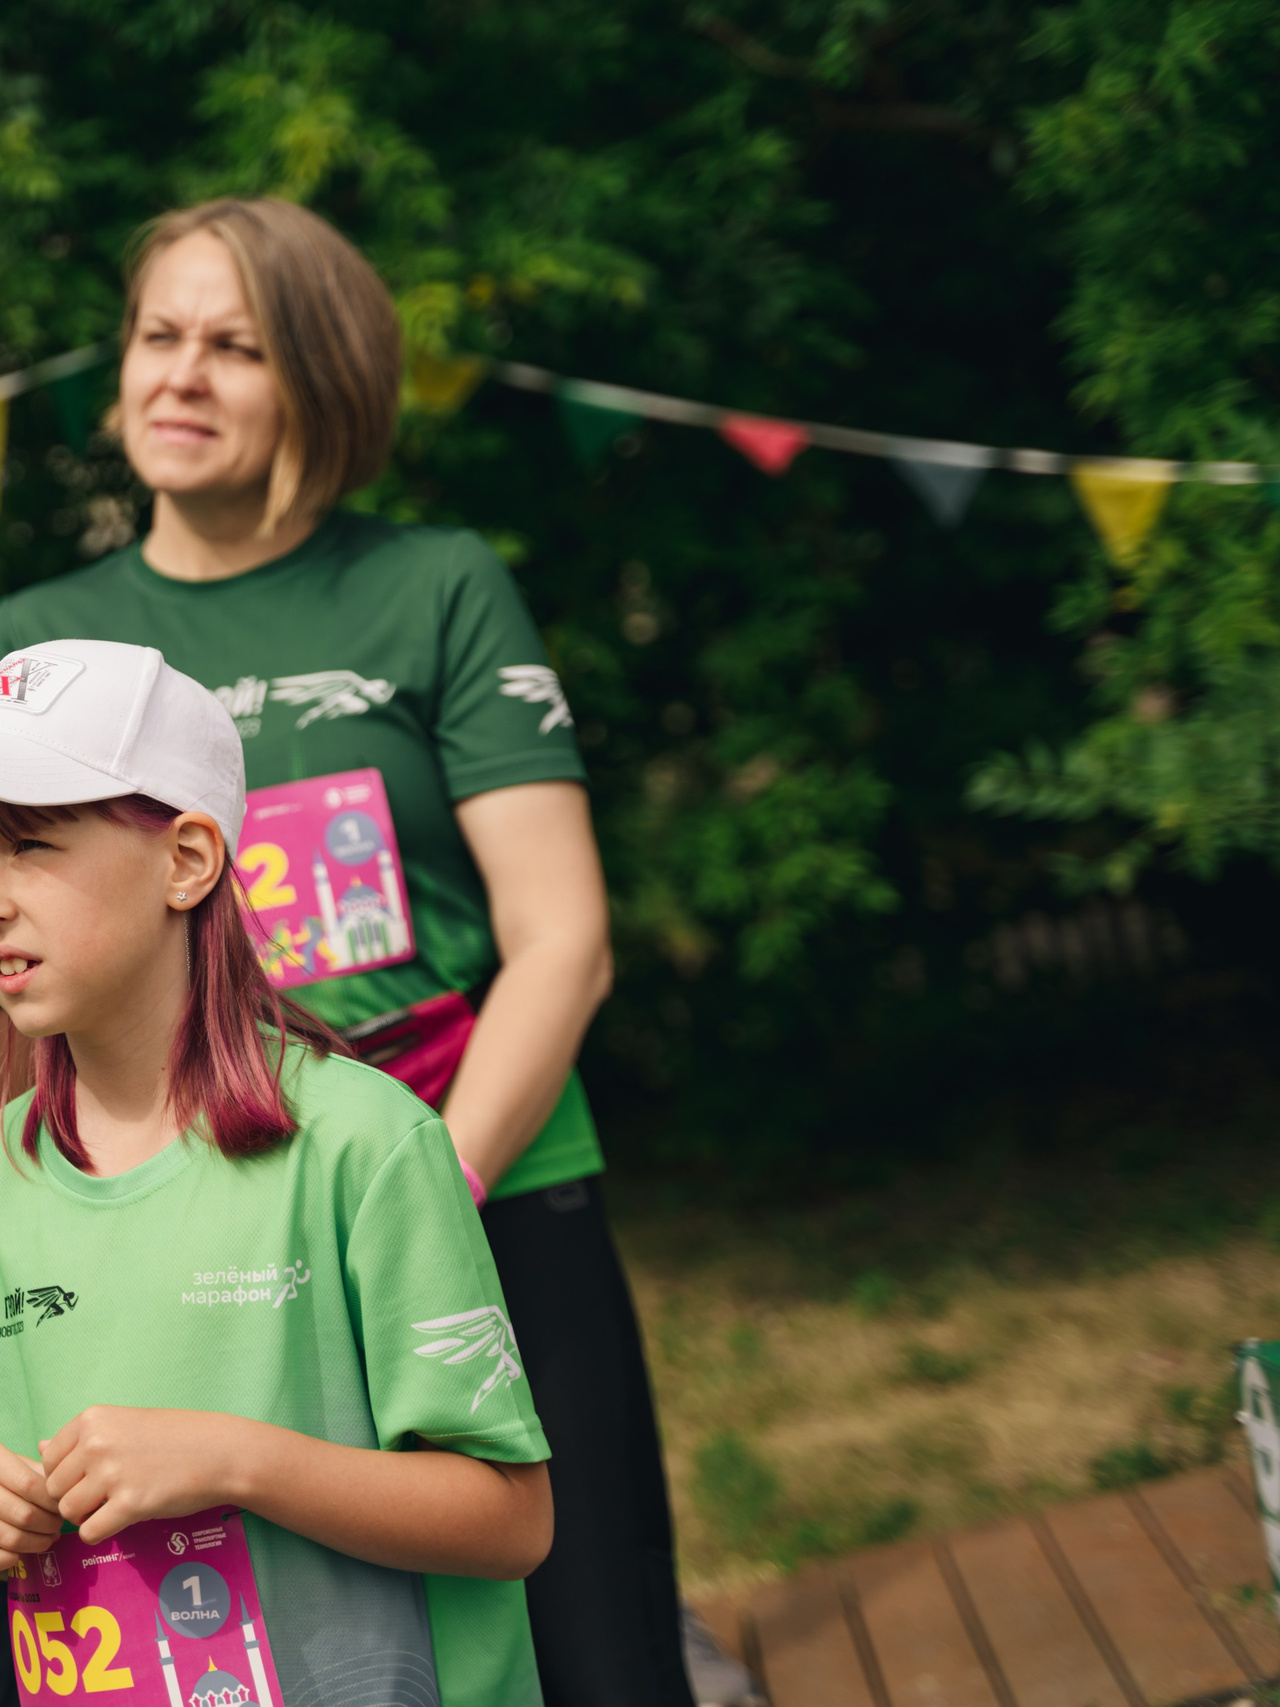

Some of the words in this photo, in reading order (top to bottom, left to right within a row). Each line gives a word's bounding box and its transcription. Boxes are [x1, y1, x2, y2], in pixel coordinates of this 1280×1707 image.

[192, 1262, 279, 1286] зелёный
[181, 1284, 272, 1307] марафон
[183, 1576, 203, 1606] 1
[171, 1610, 221, 1621] ВОЛНА
[12, 1605, 135, 1696] 052
